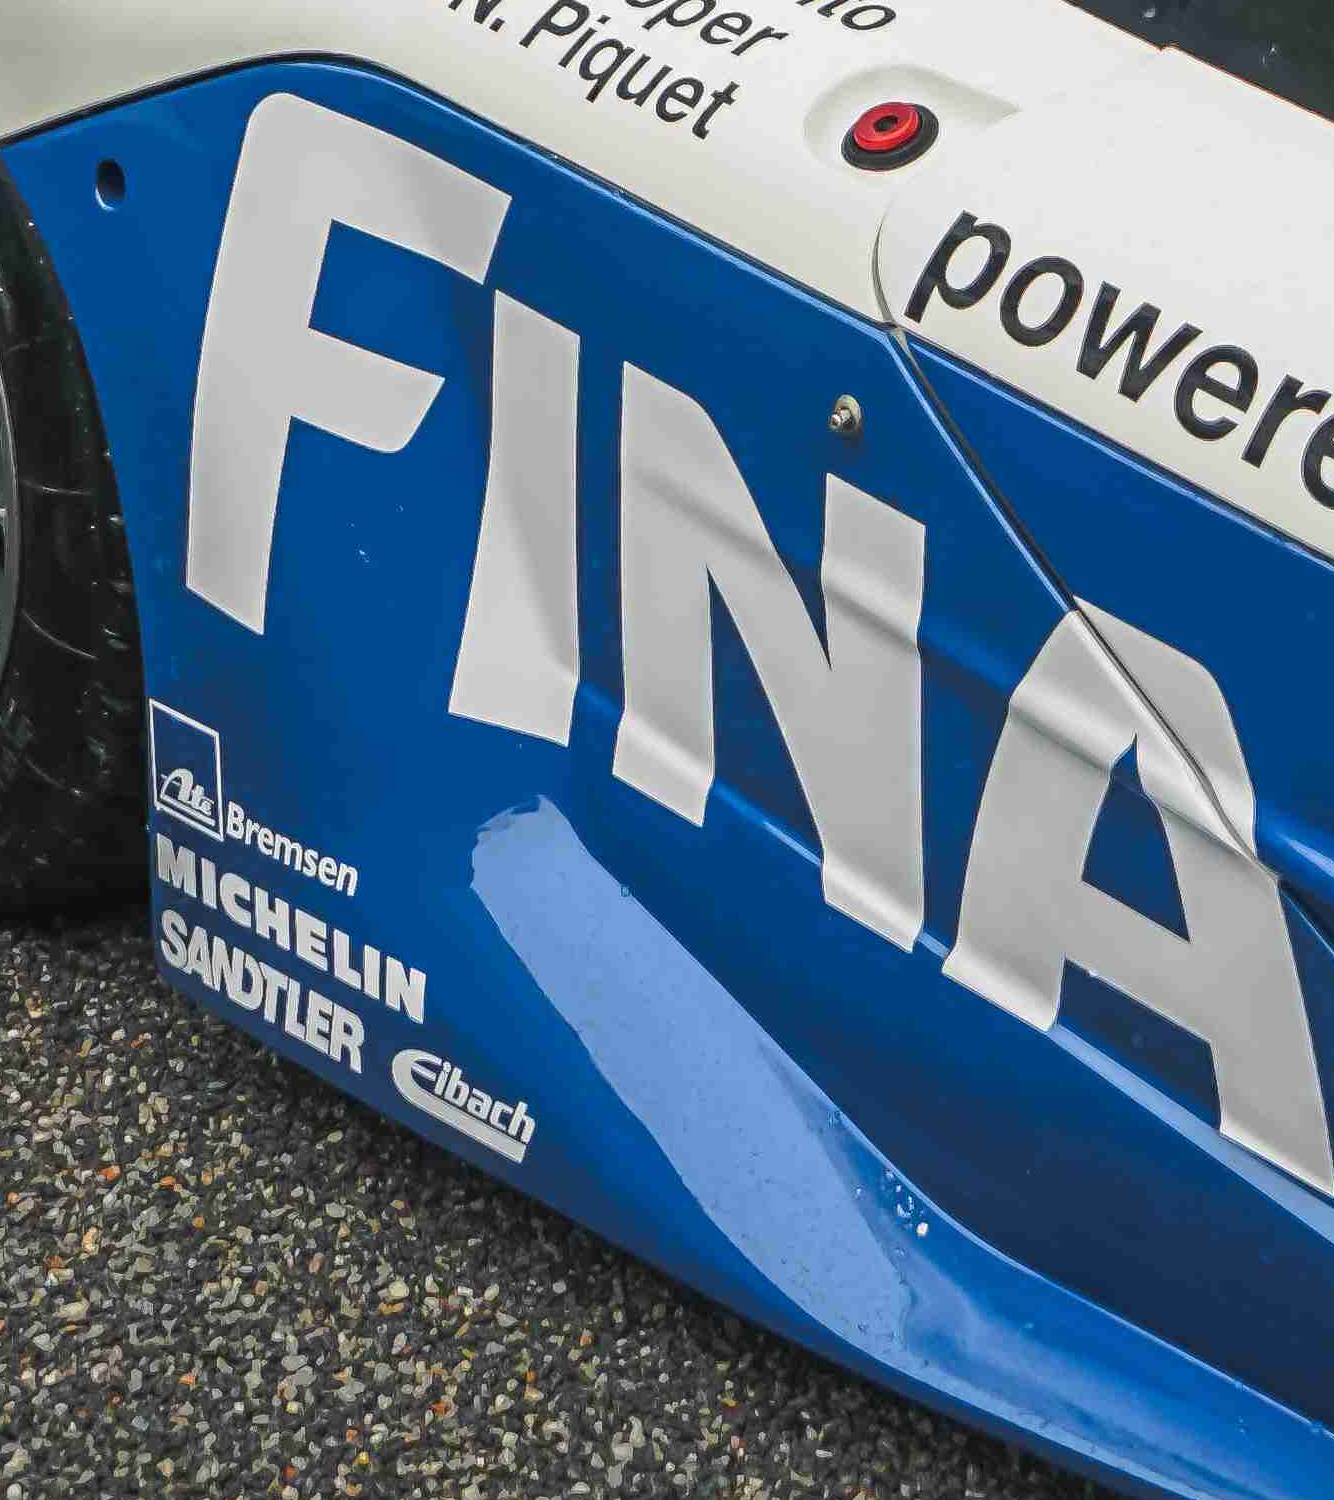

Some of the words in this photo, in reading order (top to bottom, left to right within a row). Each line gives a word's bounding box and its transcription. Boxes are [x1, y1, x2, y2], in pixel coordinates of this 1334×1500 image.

[226, 800, 359, 897] Bremsen
[155, 833, 427, 1024] MICHELIN
[159, 908, 366, 1074] SANDTLER
[391, 1047, 537, 1164] Eibach
